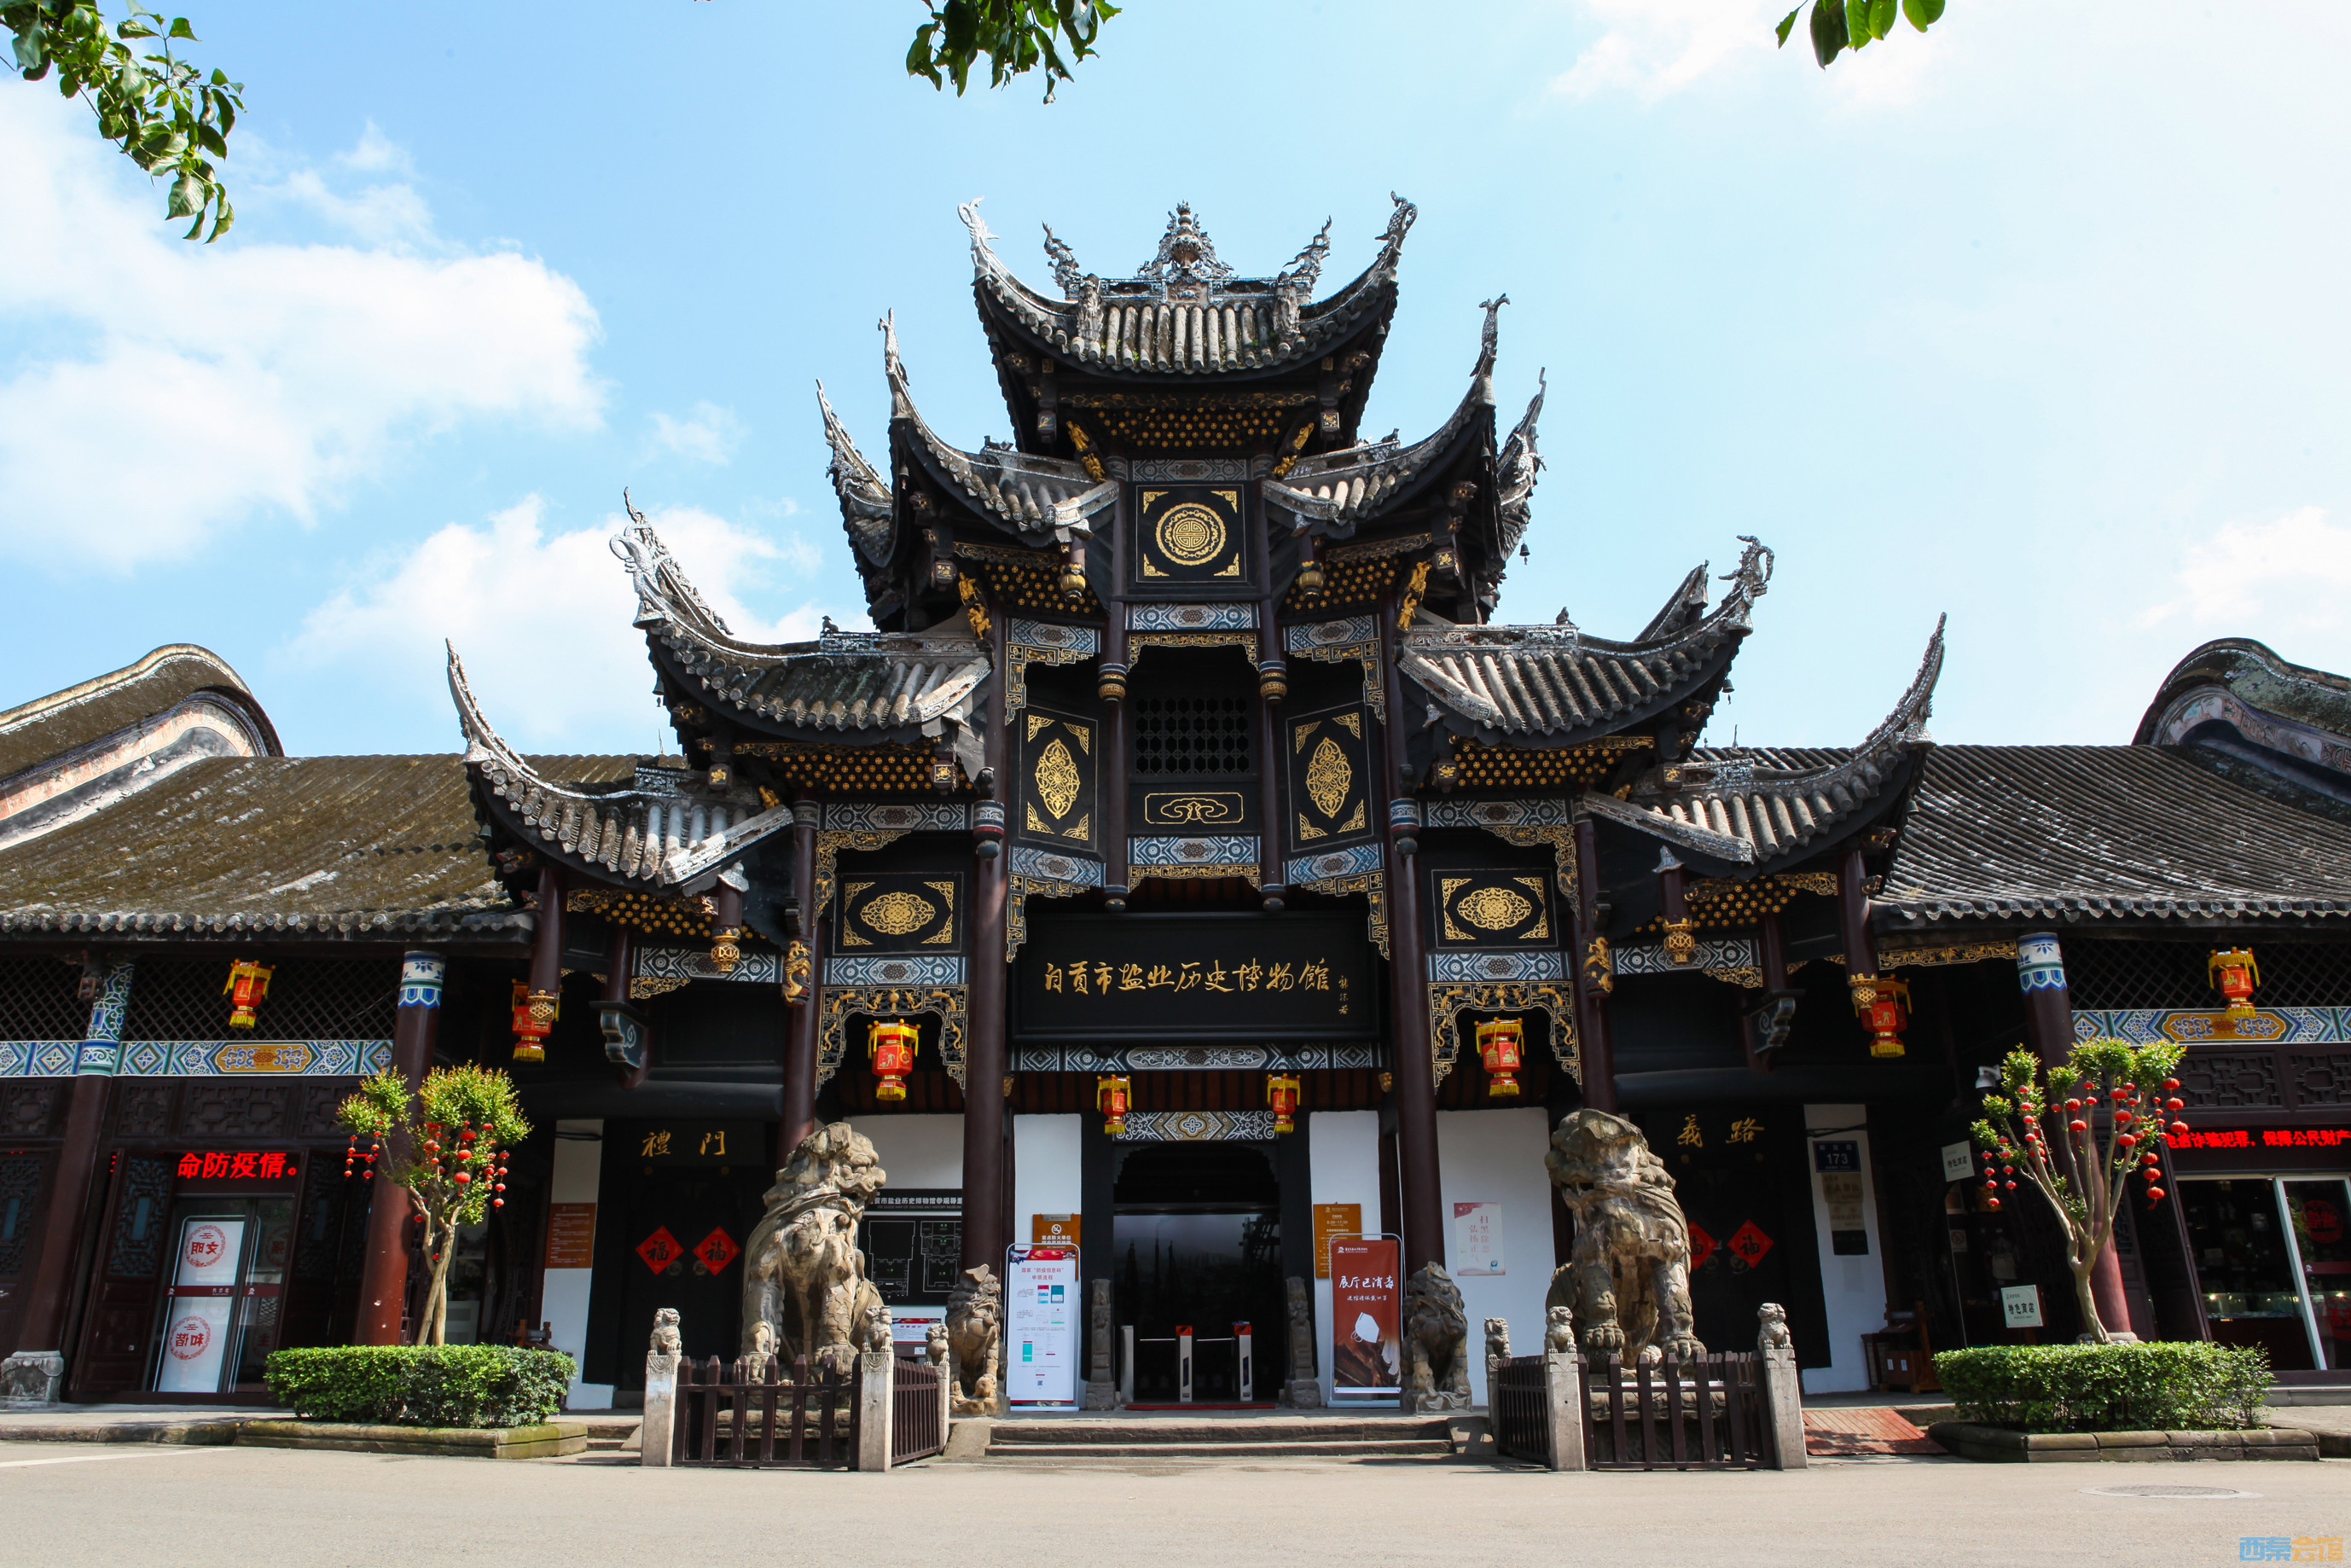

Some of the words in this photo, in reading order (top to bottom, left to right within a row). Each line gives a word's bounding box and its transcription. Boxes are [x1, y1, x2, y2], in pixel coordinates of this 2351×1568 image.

[1677, 1114, 1765, 1147] 義路
[2166, 1130, 2351, 1148] 电信诈骗犯罪，保障公民财产
[641, 1130, 725, 1158] 禮門
[1826, 1153, 1849, 1164] 173
[646, 1240, 670, 1262] 福
[705, 1240, 727, 1262] 福
[1740, 1234, 1761, 1256] 福
[1338, 1275, 1394, 1289] 展厅已消毒
[2008, 1302, 2034, 1315] 特色商店
